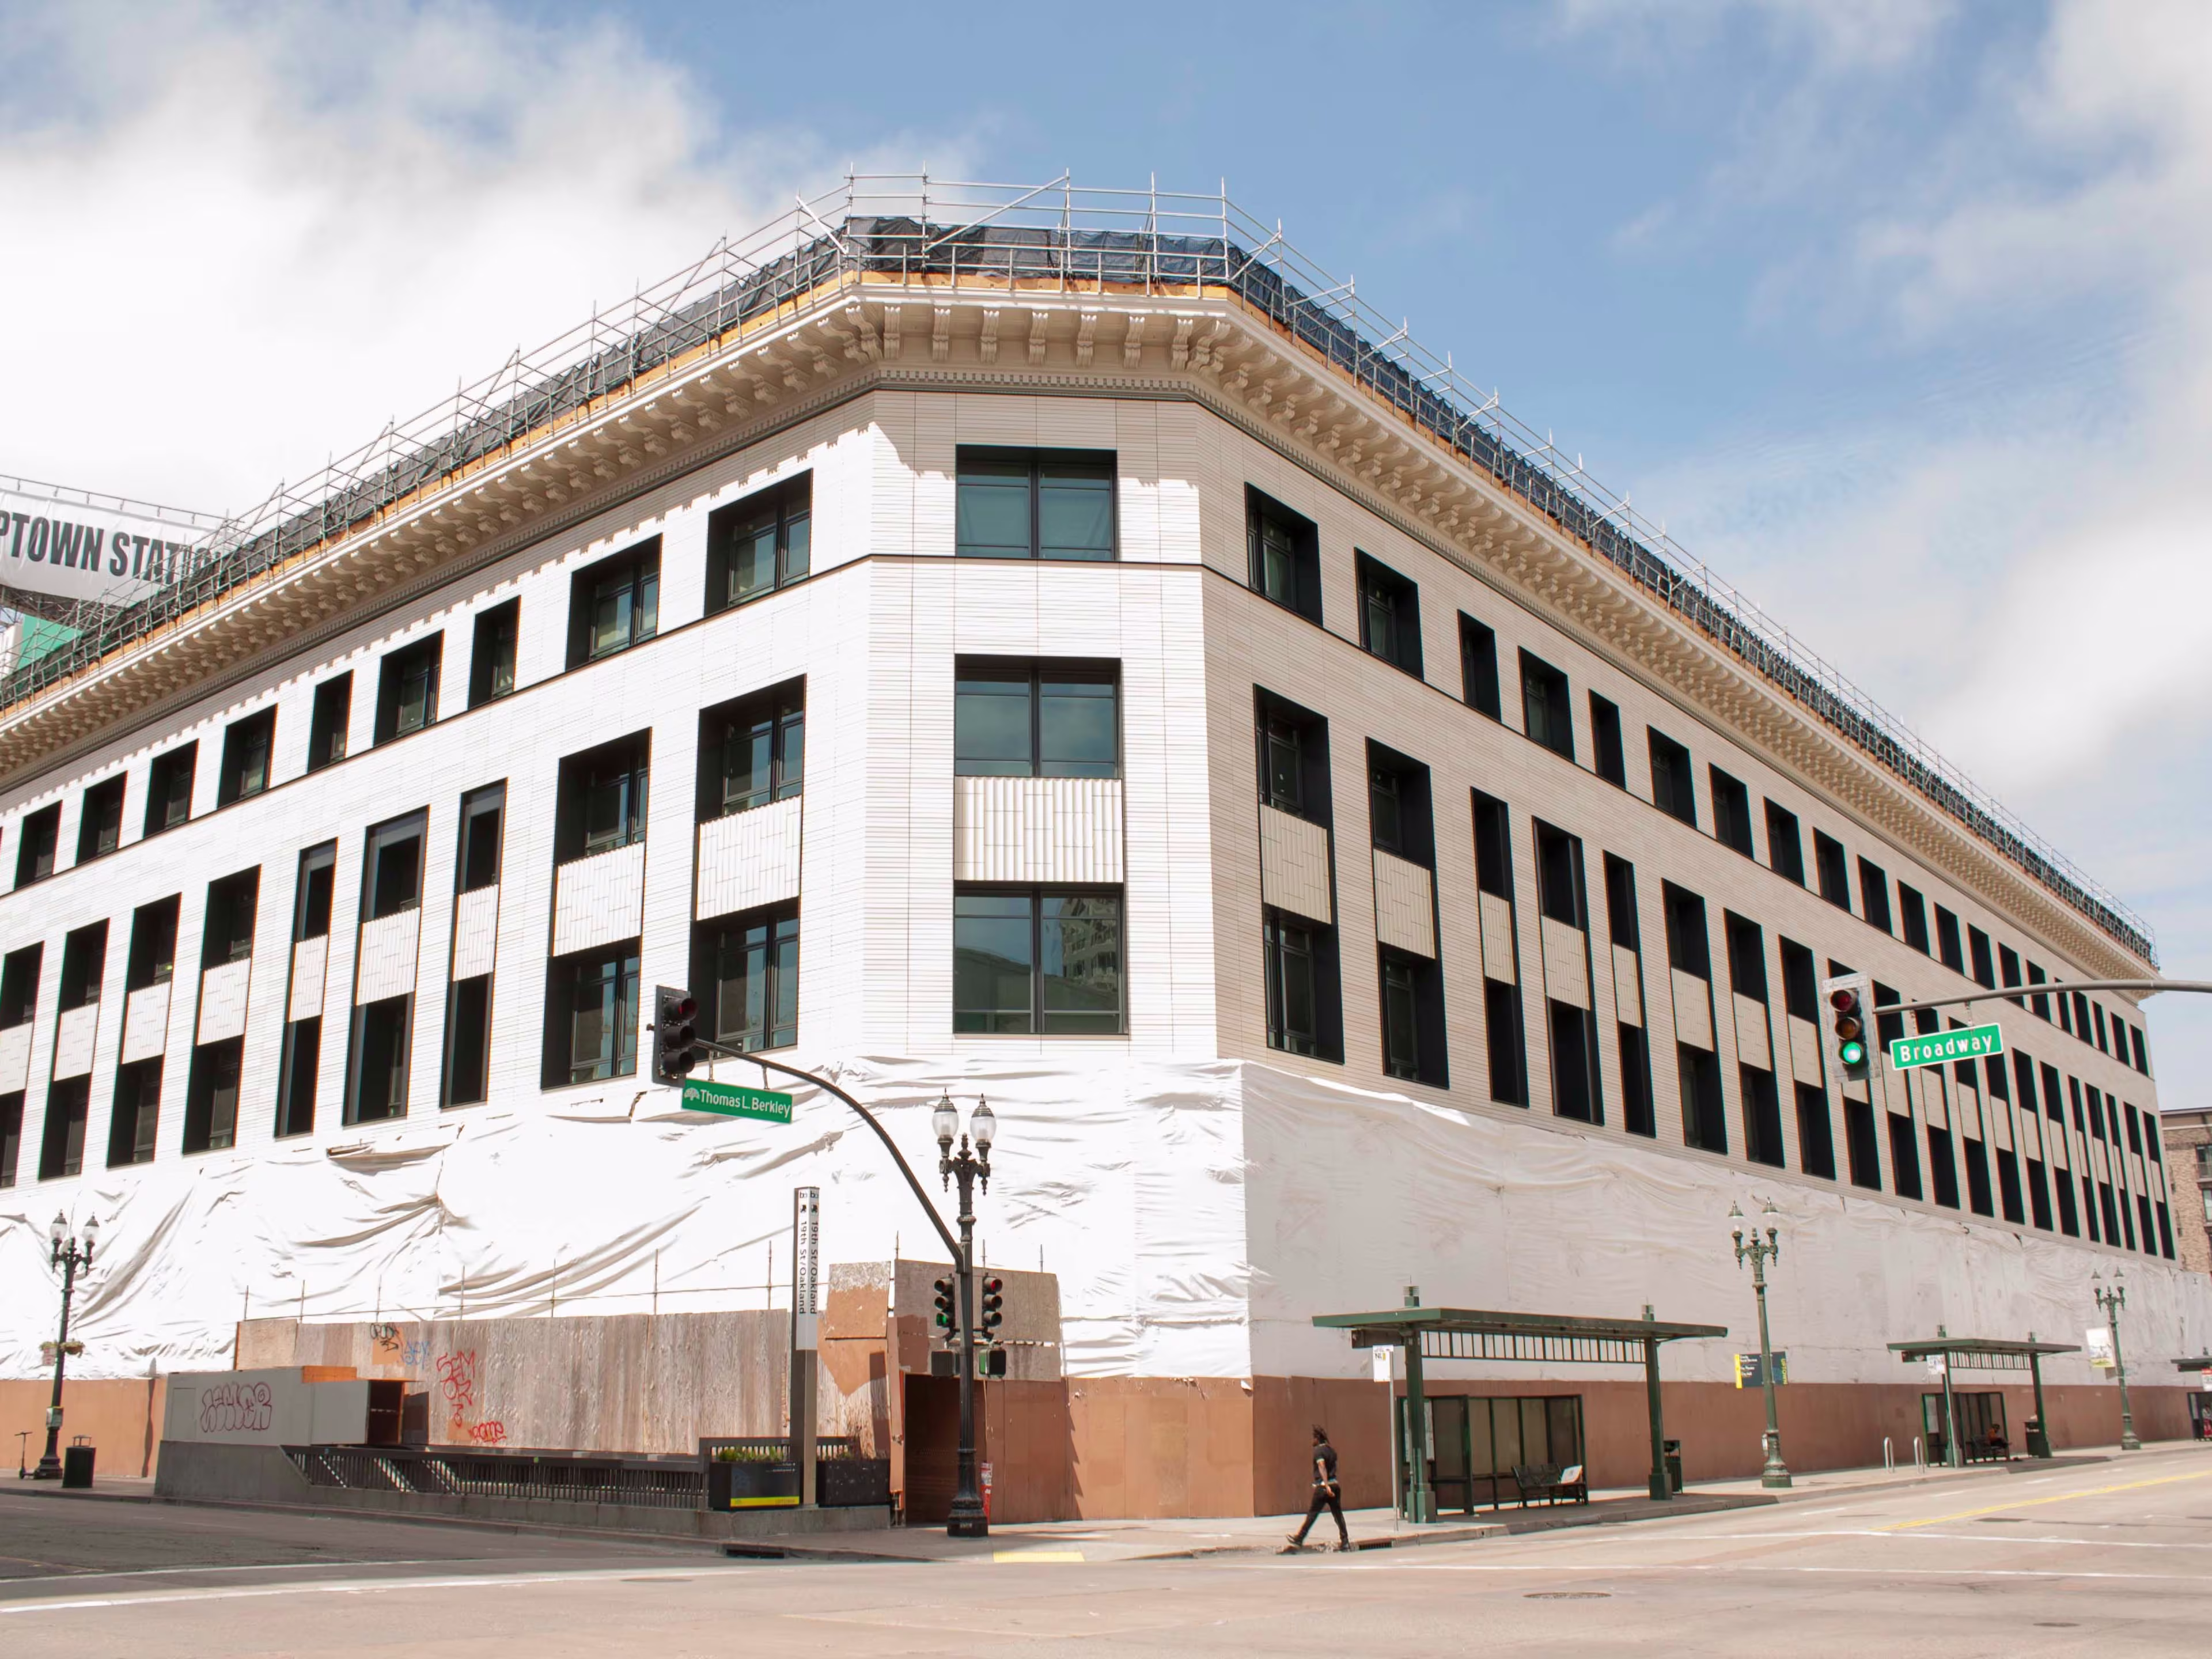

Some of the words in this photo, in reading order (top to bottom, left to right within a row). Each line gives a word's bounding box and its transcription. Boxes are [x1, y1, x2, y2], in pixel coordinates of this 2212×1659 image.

[109, 532, 222, 585] STATI
[1900, 1035, 1992, 1062] Broadway
[700, 1089, 740, 1108] Thomas
[752, 1097, 791, 1118] Berkley
